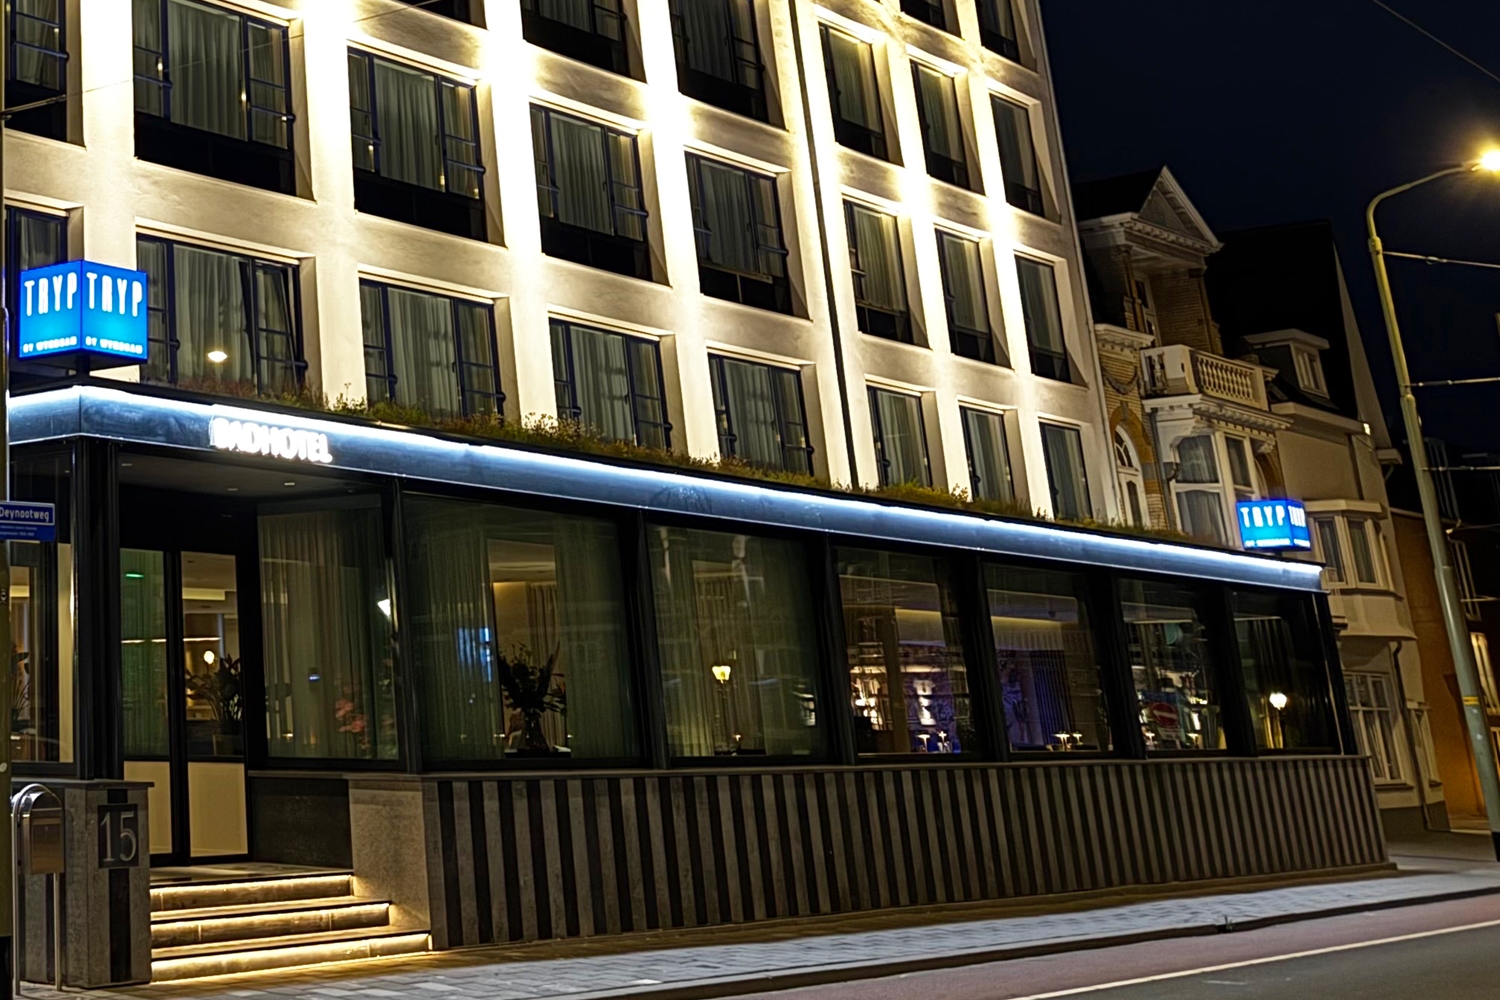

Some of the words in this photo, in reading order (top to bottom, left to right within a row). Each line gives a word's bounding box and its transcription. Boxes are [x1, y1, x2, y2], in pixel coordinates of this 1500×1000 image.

[24, 272, 77, 317] TRYP
[86, 272, 143, 317] TRYP
[1240, 506, 1285, 528] TRYP
[100, 811, 137, 862] 15
